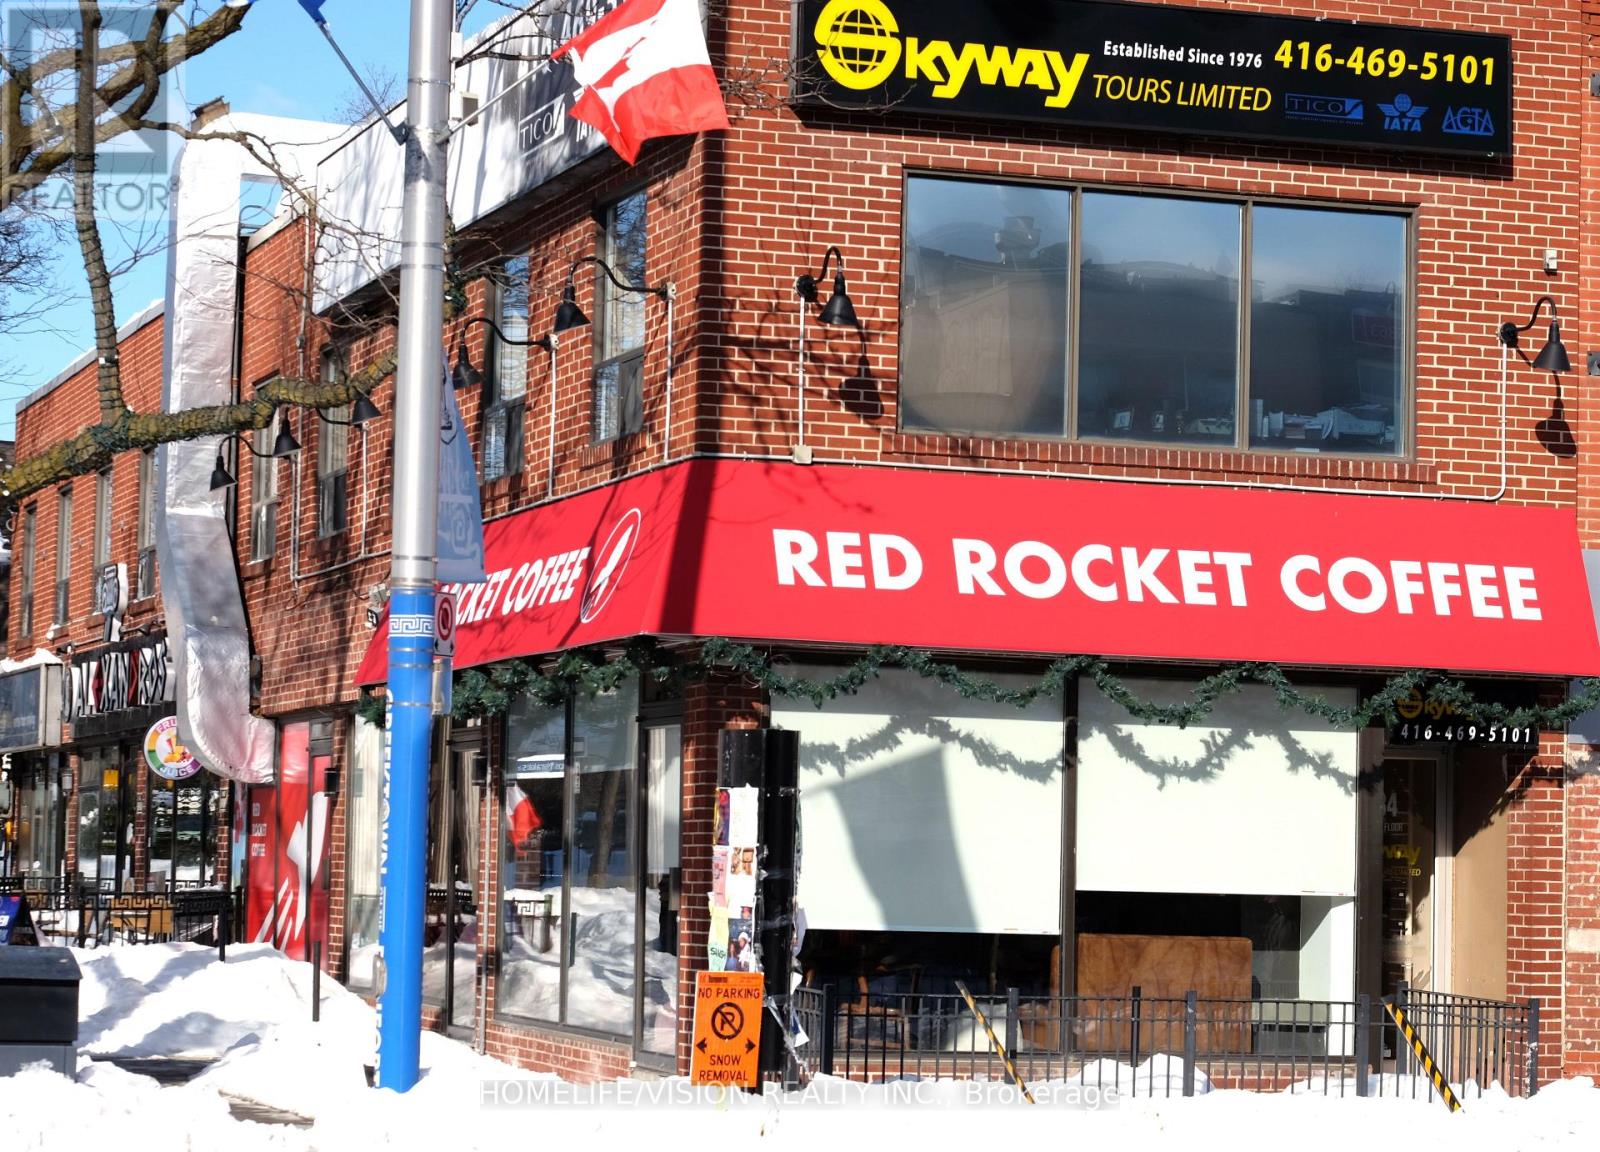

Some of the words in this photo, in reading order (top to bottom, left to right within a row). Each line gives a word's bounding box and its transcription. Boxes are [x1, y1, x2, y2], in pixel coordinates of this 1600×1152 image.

[1103, 40, 1184, 62] Established
[1188, 48, 1224, 66] Since
[1229, 52, 1262, 68] 1976
[1274, 39, 1494, 86] 416-469-5101
[1093, 73, 1172, 105] TOURS
[1177, 81, 1272, 112] LIMITED
[1288, 97, 1344, 114] TICO
[520, 111, 553, 149] TICO
[1384, 117, 1422, 132] IATA
[1441, 105, 1496, 137] ACTA
[501, 546, 592, 616] COFFEE
[772, 528, 924, 591] RED
[951, 537, 1254, 608] ROCKET
[1279, 554, 1543, 621] COFFEE
[1400, 723, 1531, 743] 416-469-5101
[159, 763, 194, 778] JUICE
[698, 987, 713, 999] NO
[716, 987, 760, 999] PARKING
[709, 1054, 742, 1066] SNOW
[699, 1069, 748, 1081] REMOVAL
